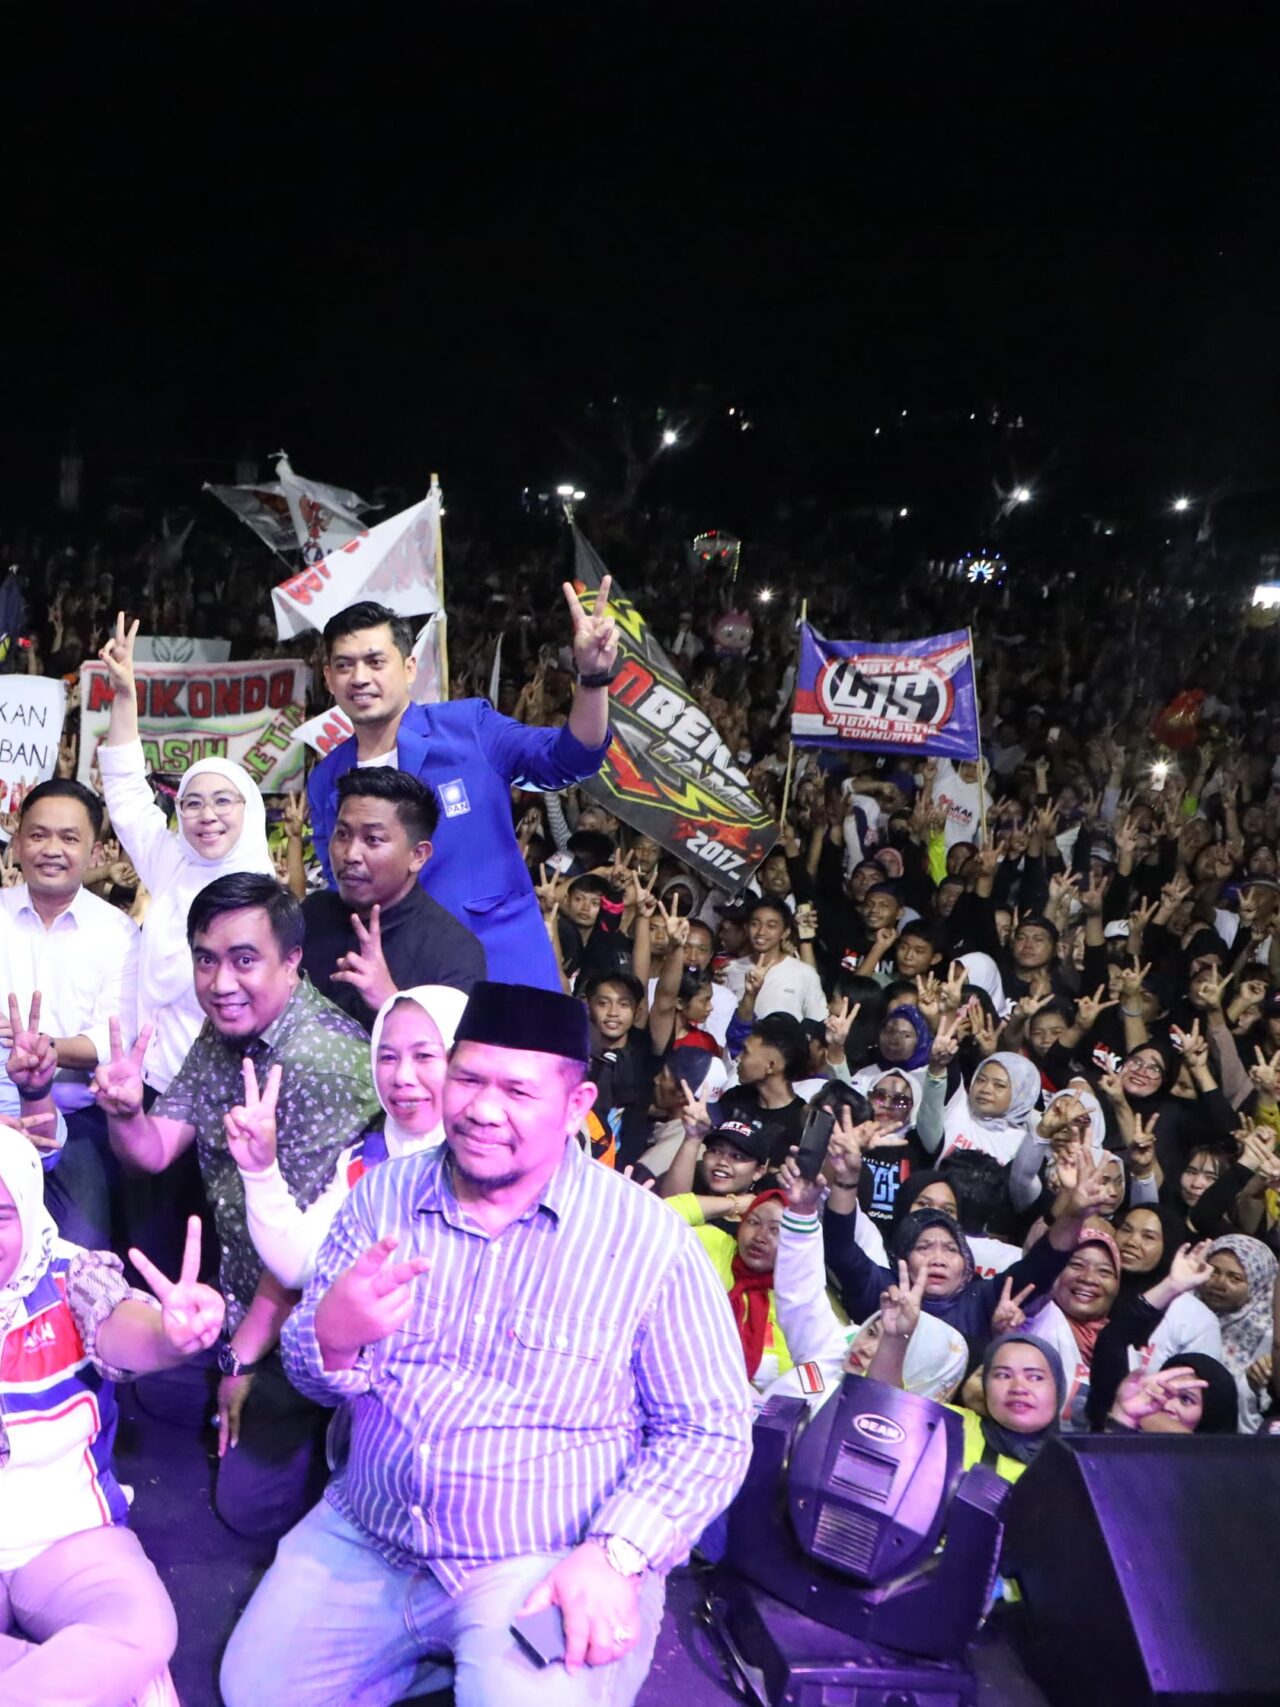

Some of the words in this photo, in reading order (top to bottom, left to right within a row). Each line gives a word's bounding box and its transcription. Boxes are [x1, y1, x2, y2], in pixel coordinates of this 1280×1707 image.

[91, 736, 228, 773] ASIH
[447, 804, 469, 815] PAN
[859, 1418, 901, 1438] BEAM
